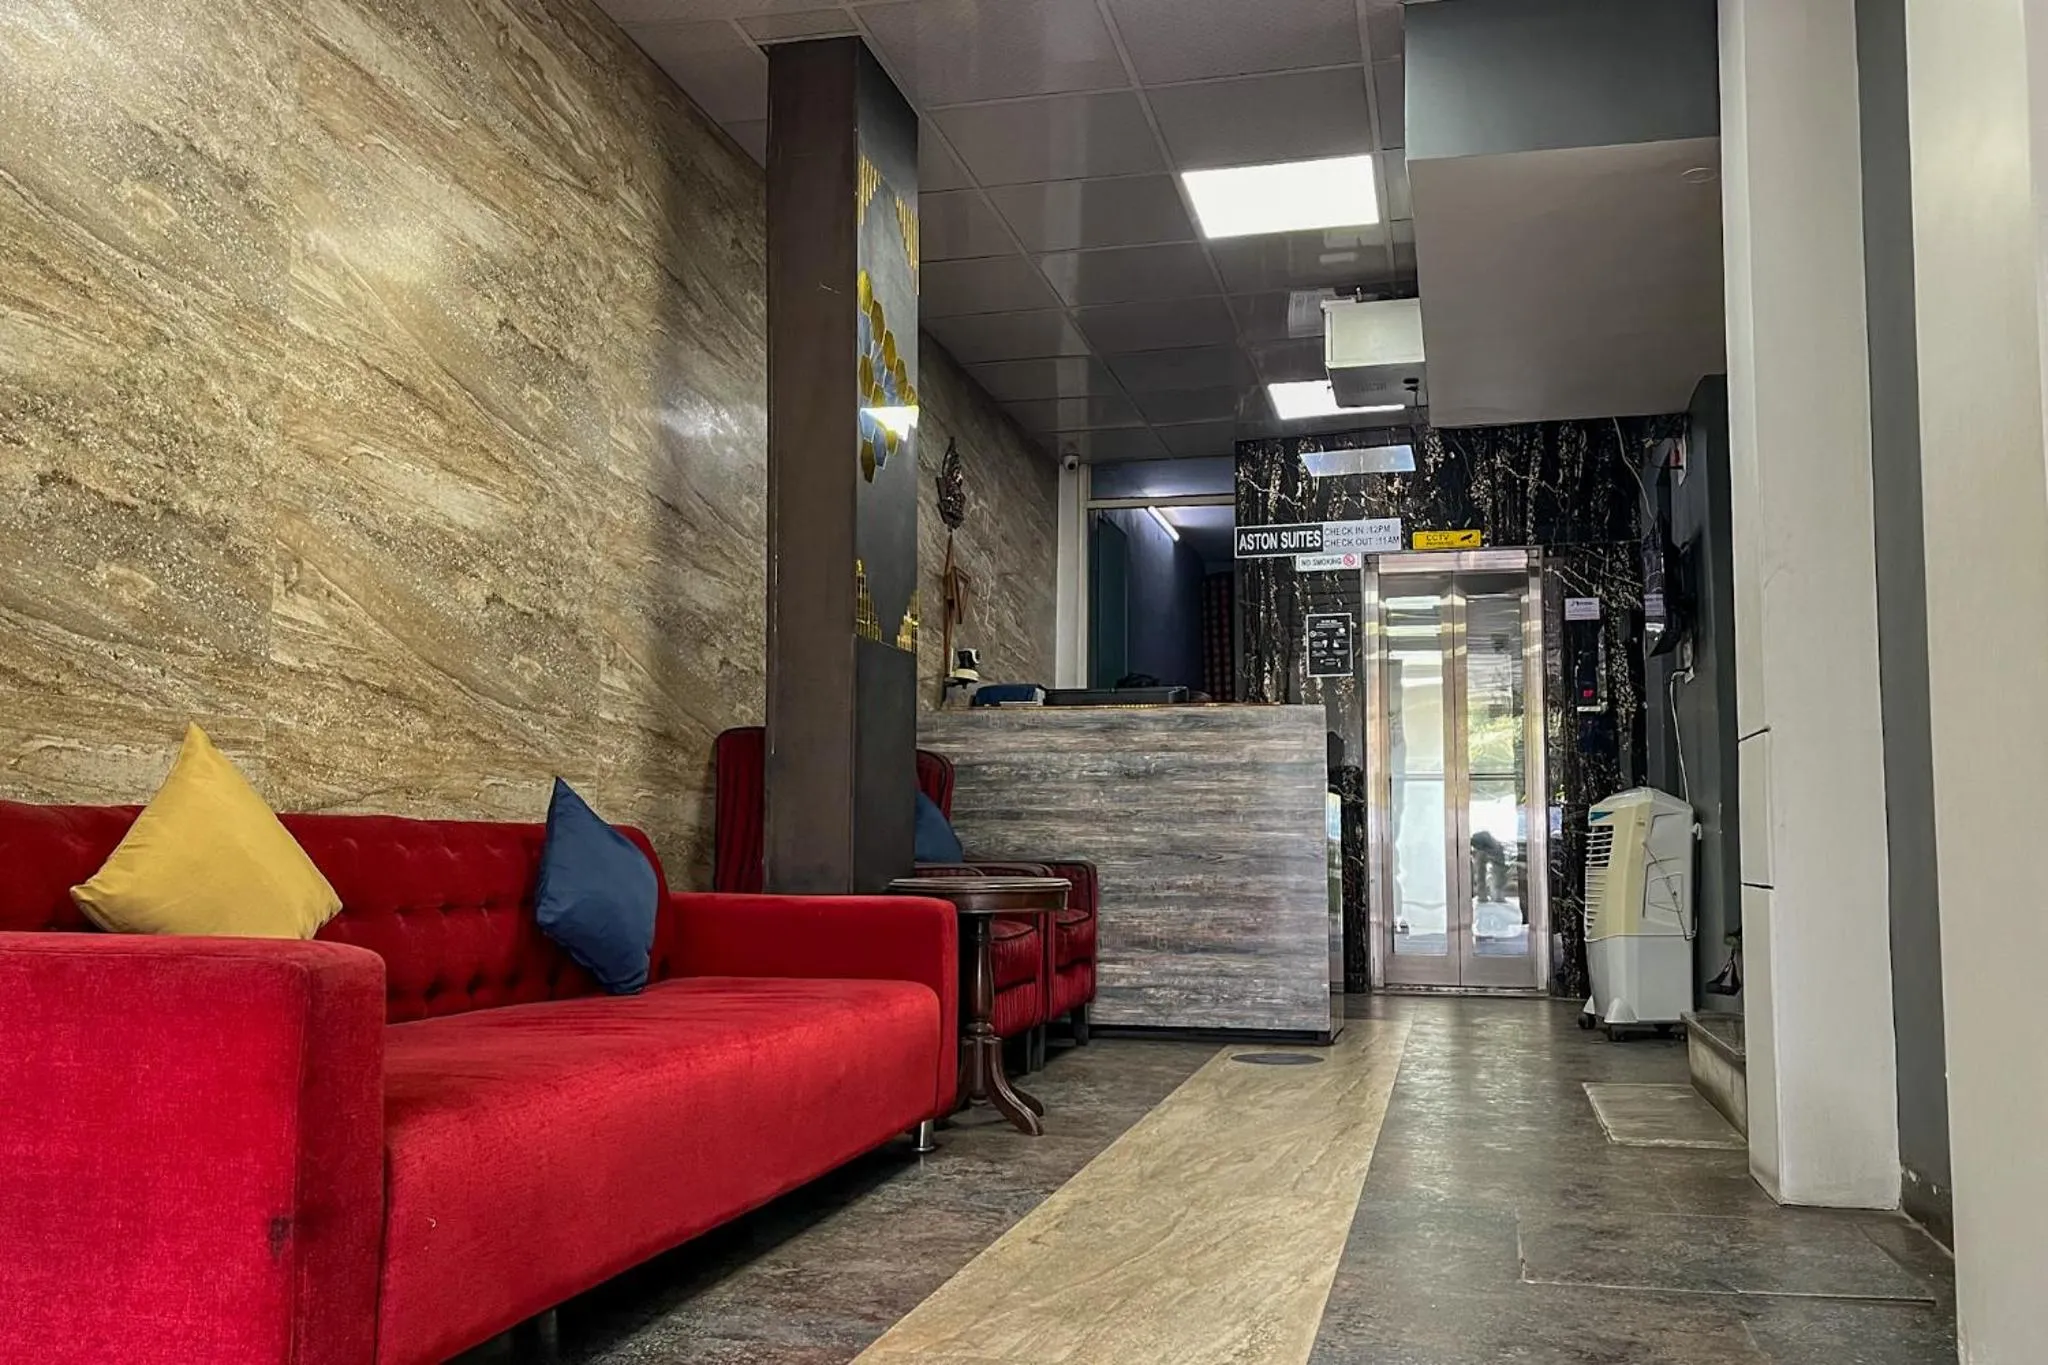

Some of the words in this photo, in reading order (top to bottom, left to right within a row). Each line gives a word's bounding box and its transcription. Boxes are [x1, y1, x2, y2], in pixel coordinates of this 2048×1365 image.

[1324, 526, 1352, 536] CHECK
[1355, 525, 1364, 534] IN
[1239, 533, 1278, 551] ASTON
[1280, 530, 1322, 549] SUITES
[1324, 538, 1353, 548] CHECK
[1355, 537, 1373, 547] OUT
[1301, 558, 1311, 566] NO
[1313, 557, 1342, 566] SMOKING
